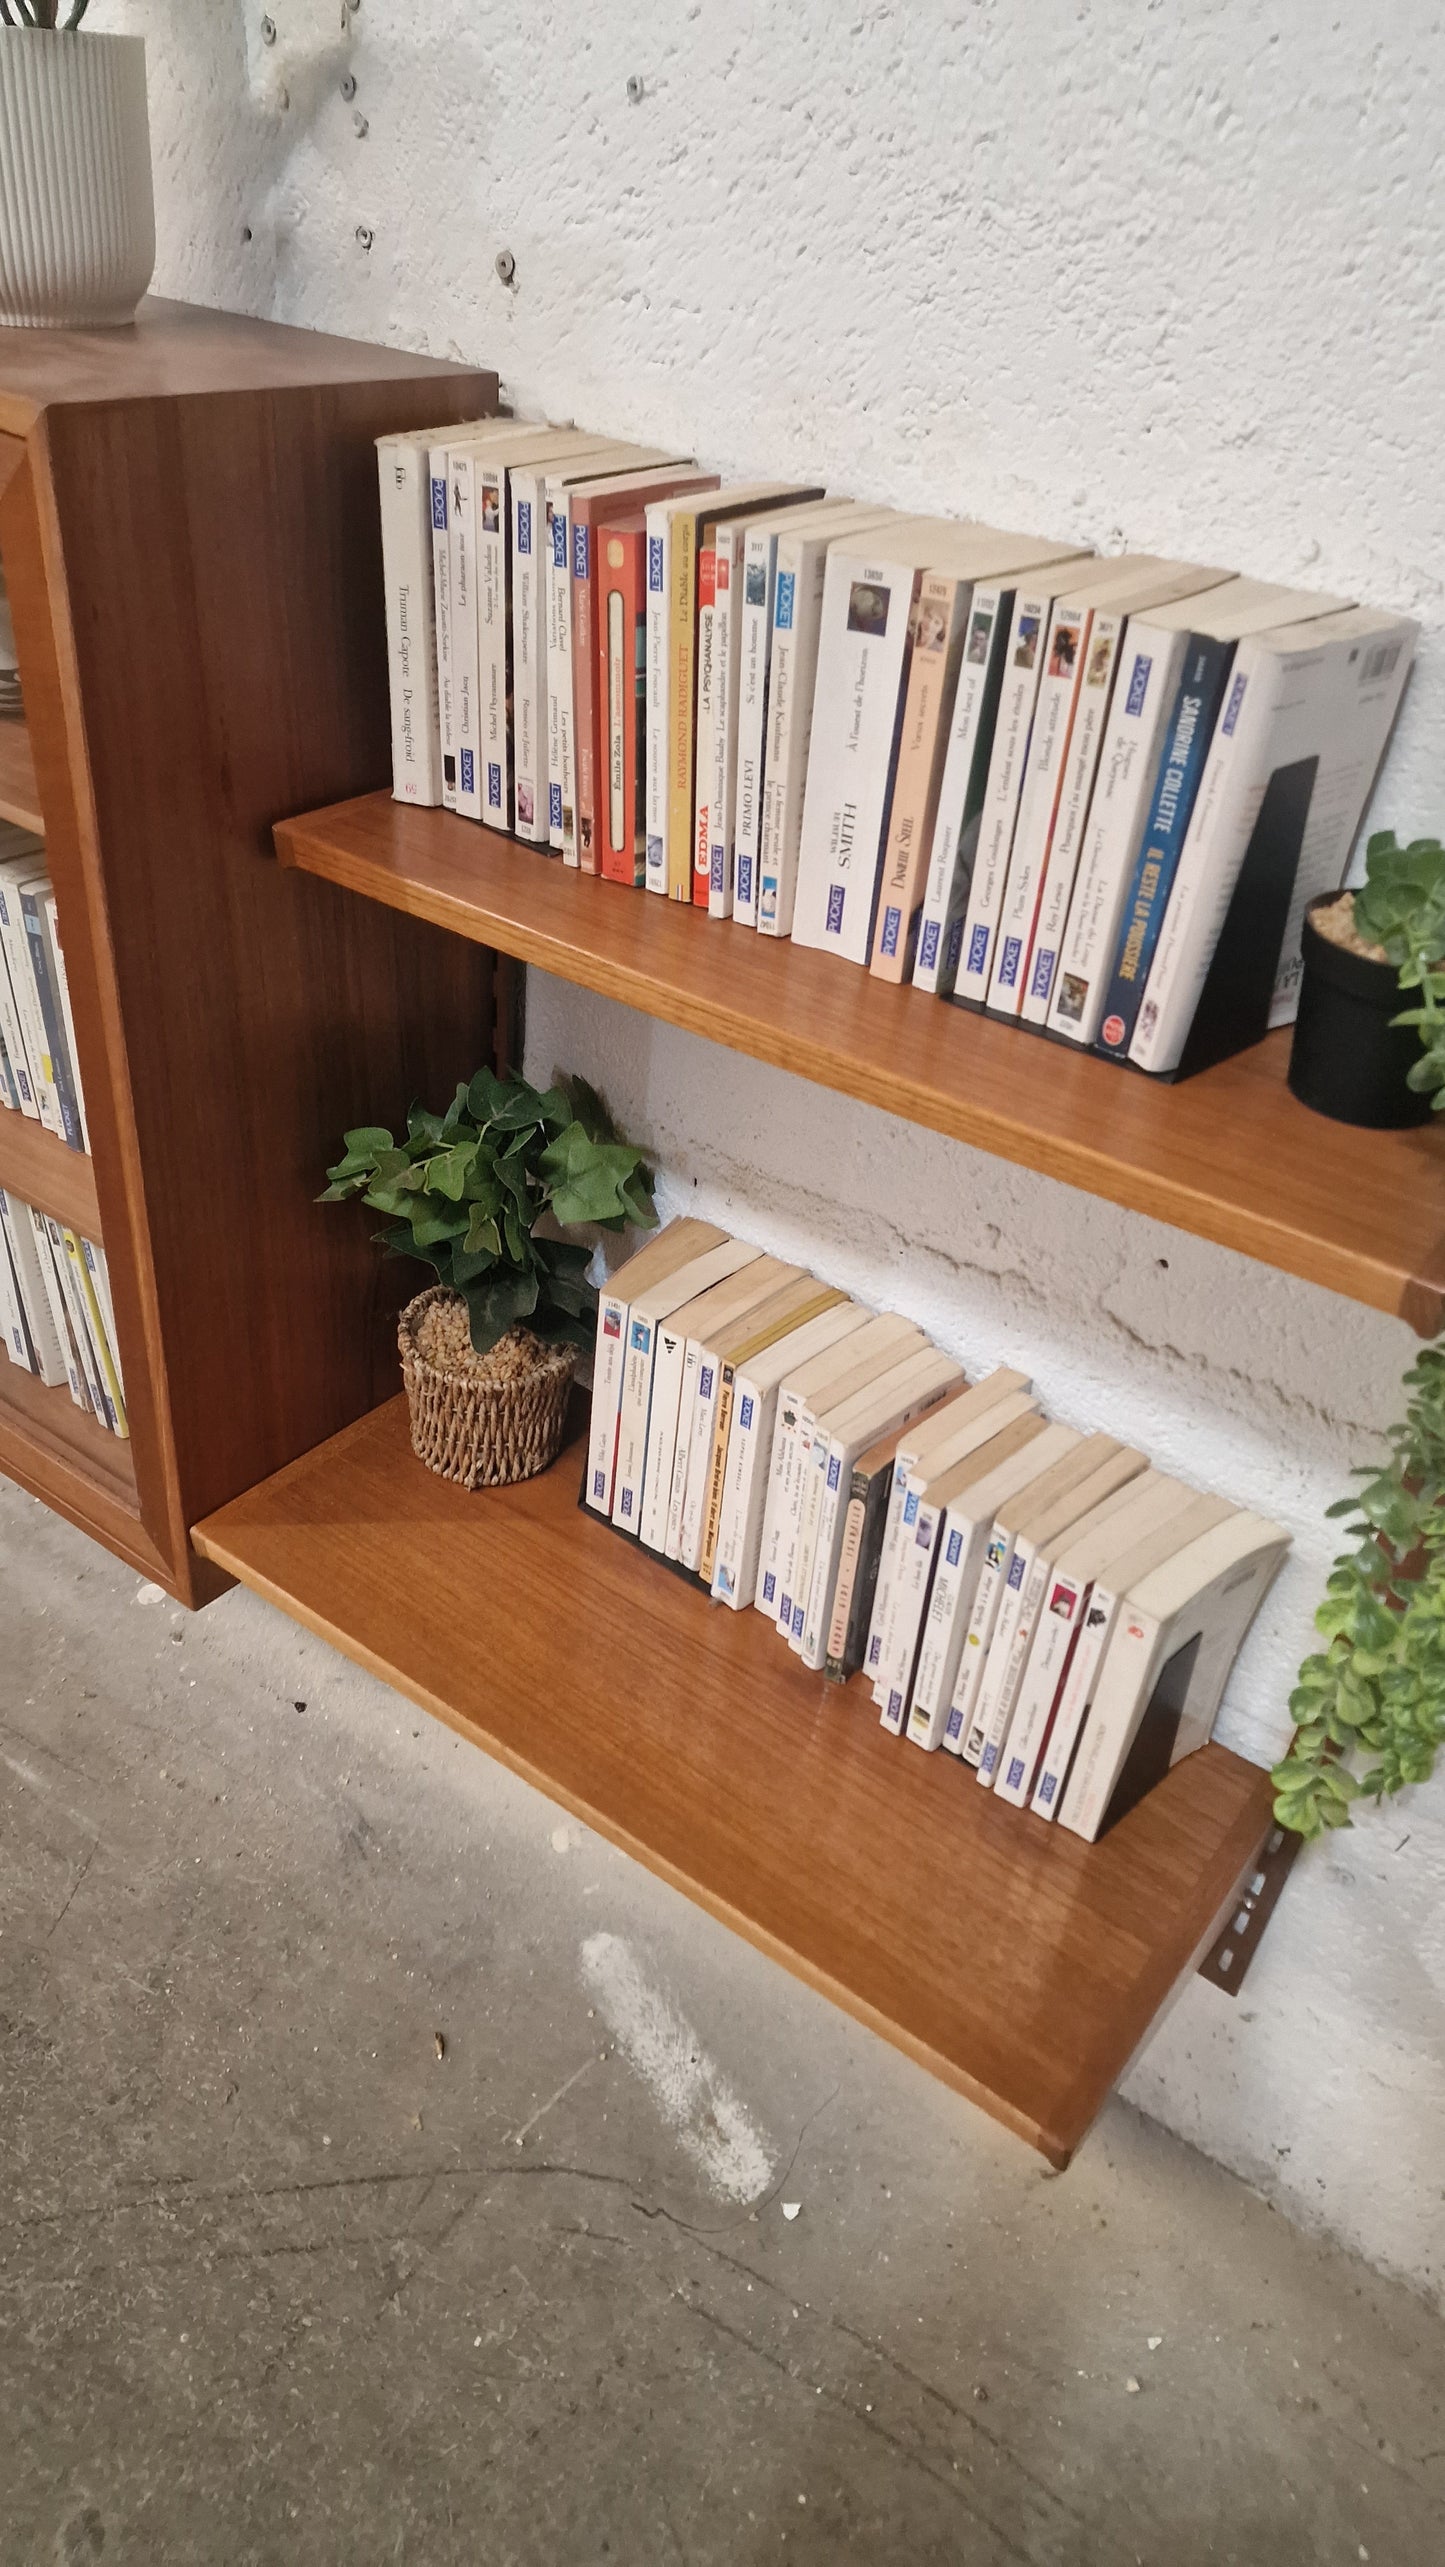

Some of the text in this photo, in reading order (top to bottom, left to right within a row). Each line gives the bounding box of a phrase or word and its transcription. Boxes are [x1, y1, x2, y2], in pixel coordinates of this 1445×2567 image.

[432, 478, 447, 530] POCKET
[518, 501, 531, 554] POCKET
[553, 513, 567, 567] POCKET
[573, 524, 588, 579] POCKET
[650, 537, 663, 592] POCKET
[459, 555, 467, 607] Le pharaon
[484, 587, 493, 625] Suzanne
[679, 573, 688, 622] Le Diable
[775, 571, 795, 630] POCKET
[398, 584, 411, 678] Truman Capote
[521, 571, 530, 665] William Shakespeare
[557, 587, 567, 652] Bernard Clavel
[703, 613, 713, 710] LA PSYCHANALYSE
[746, 619, 758, 705] Si c'est un homme
[1124, 655, 1153, 717] POCKET
[402, 689, 415, 762] De sang-froid
[461, 676, 470, 734] Christian Jacq
[550, 695, 558, 735] Grimaud
[677, 643, 688, 790] RAYMOND RADIGUET
[717, 719, 725, 731] Le
[773, 645, 789, 762] Jean-Claude Kaufmann
[853, 694, 865, 708] de
[916, 684, 929, 718] secrets
[956, 692, 974, 739] Mon best
[522, 731, 531, 769] et Juliette
[561, 711, 570, 793] Les petits bonheurs
[652, 729, 660, 741] Le
[1169, 695, 1203, 767] SANDRINE
[461, 748, 474, 793] POCKET
[488, 762, 501, 808] POCKET
[612, 734, 621, 790] Émile Zola
[550, 783, 562, 829] POCKET
[742, 759, 753, 837] PRIMO LEVI
[762, 779, 775, 864] le prince charmant
[1152, 768, 1184, 834] COLLETTE
[697, 805, 709, 868] EDMA
[772, 783, 785, 867] La femme seule et
[838, 802, 857, 869] SMITH
[894, 816, 914, 847] STEEL
[710, 844, 723, 893] POCKET
[738, 854, 752, 903] POCKET
[1133, 847, 1165, 918] IL RESTE LA
[826, 884, 845, 934] POCKET
[880, 905, 902, 957] POCKET
[1045, 912, 1059, 932] Roy
[919, 920, 941, 970] POCKET
[967, 924, 990, 975] POCKET
[999, 936, 1022, 988] POCKET
[1031, 948, 1056, 1000] POCKET
[16, 1068, 32, 1102] POCKET
[699, 1366, 714, 1399] POCKET
[720, 1389, 730, 1408] Pierre
[739, 1395, 754, 1431] POCKET
[713, 1444, 725, 1468] Jacques
[713, 1468, 723, 1481] Brel
[735, 1438, 747, 1492] SOPHIE KINSELLA
[826, 1454, 842, 1491] POCKET
[593, 1470, 606, 1500] POCKET
[620, 1486, 633, 1518] POCKET
[708, 1506, 718, 1520] dort
[945, 1529, 963, 1567] POCKET
[1006, 1553, 1026, 1592] POCKET
[762, 1570, 776, 1603] POCKET
[931, 1576, 949, 1624] MICHELET
